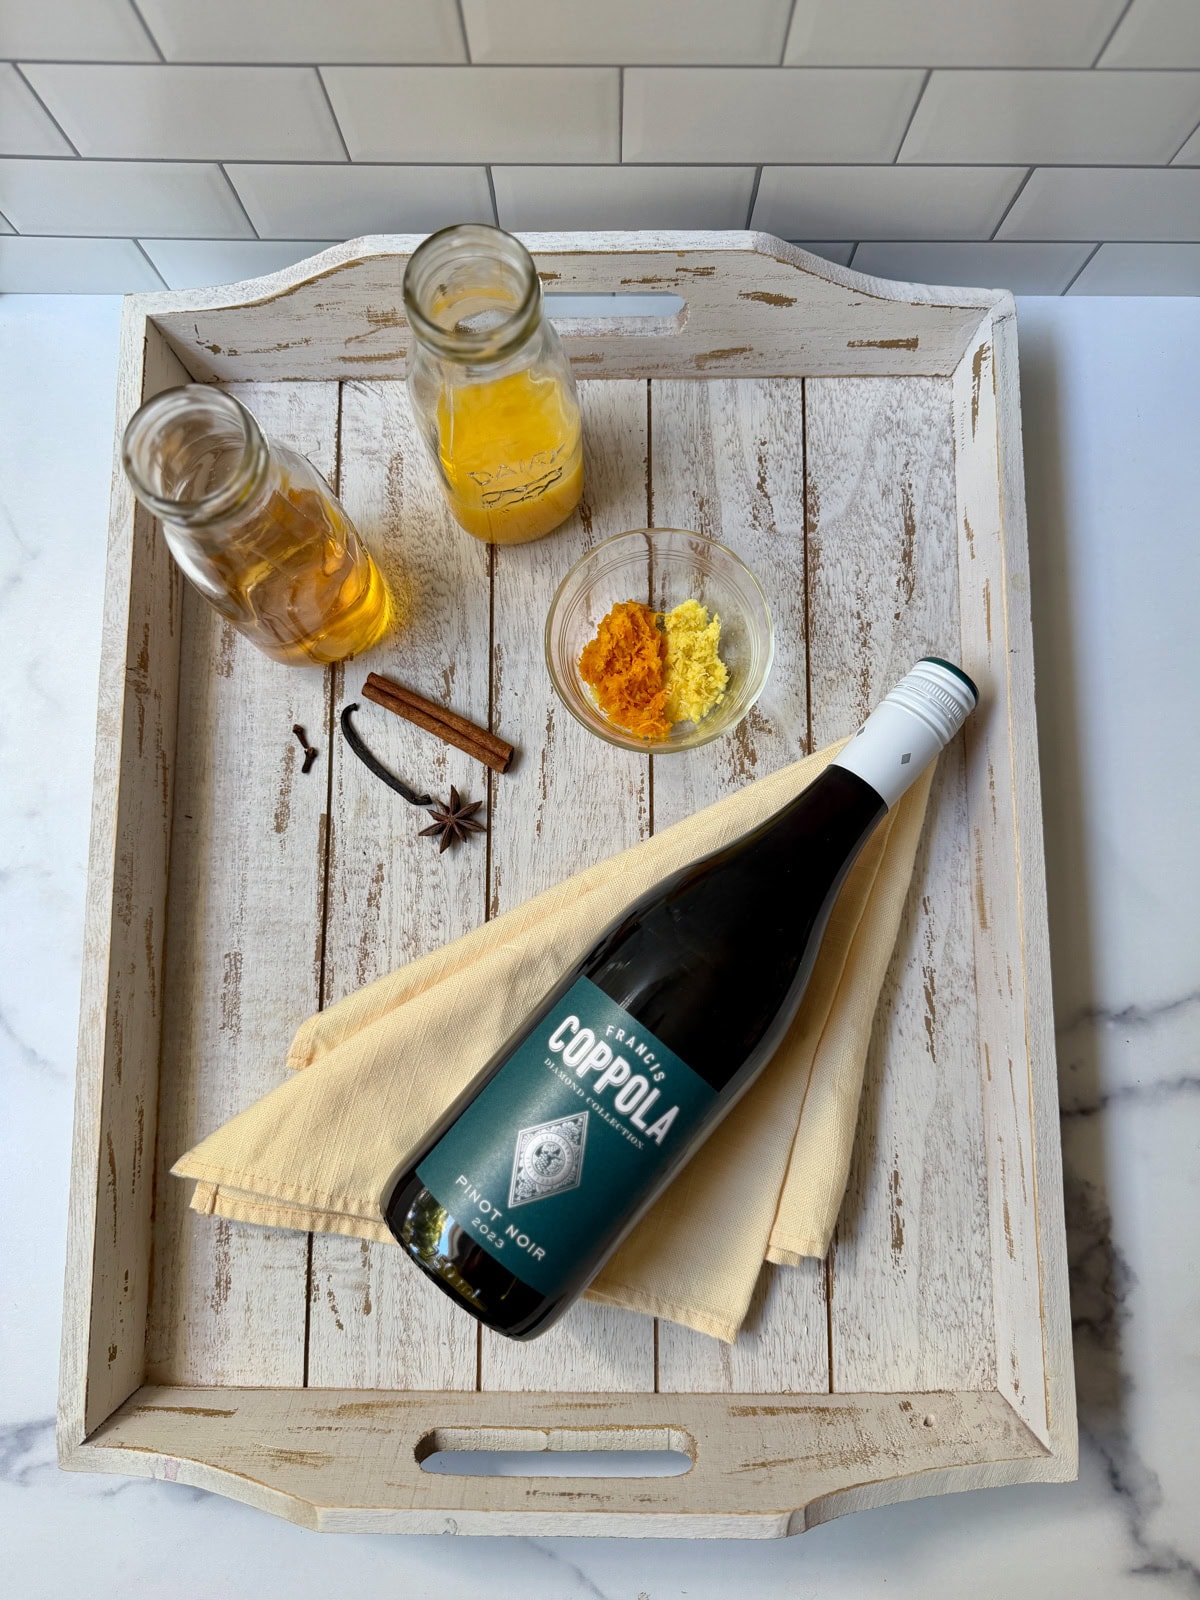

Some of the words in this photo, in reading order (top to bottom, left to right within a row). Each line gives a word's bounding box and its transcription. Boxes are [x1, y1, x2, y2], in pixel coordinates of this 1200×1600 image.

[548, 1015, 680, 1146] COPPOLA
[605, 1024, 666, 1083] FRANCIS
[543, 1057, 585, 1097] DIAMOND
[585, 1096, 645, 1149] COLLECTION
[455, 1174, 503, 1221] PINOT
[505, 1224, 546, 1262] NOIR
[471, 1217, 505, 1249] 2023
